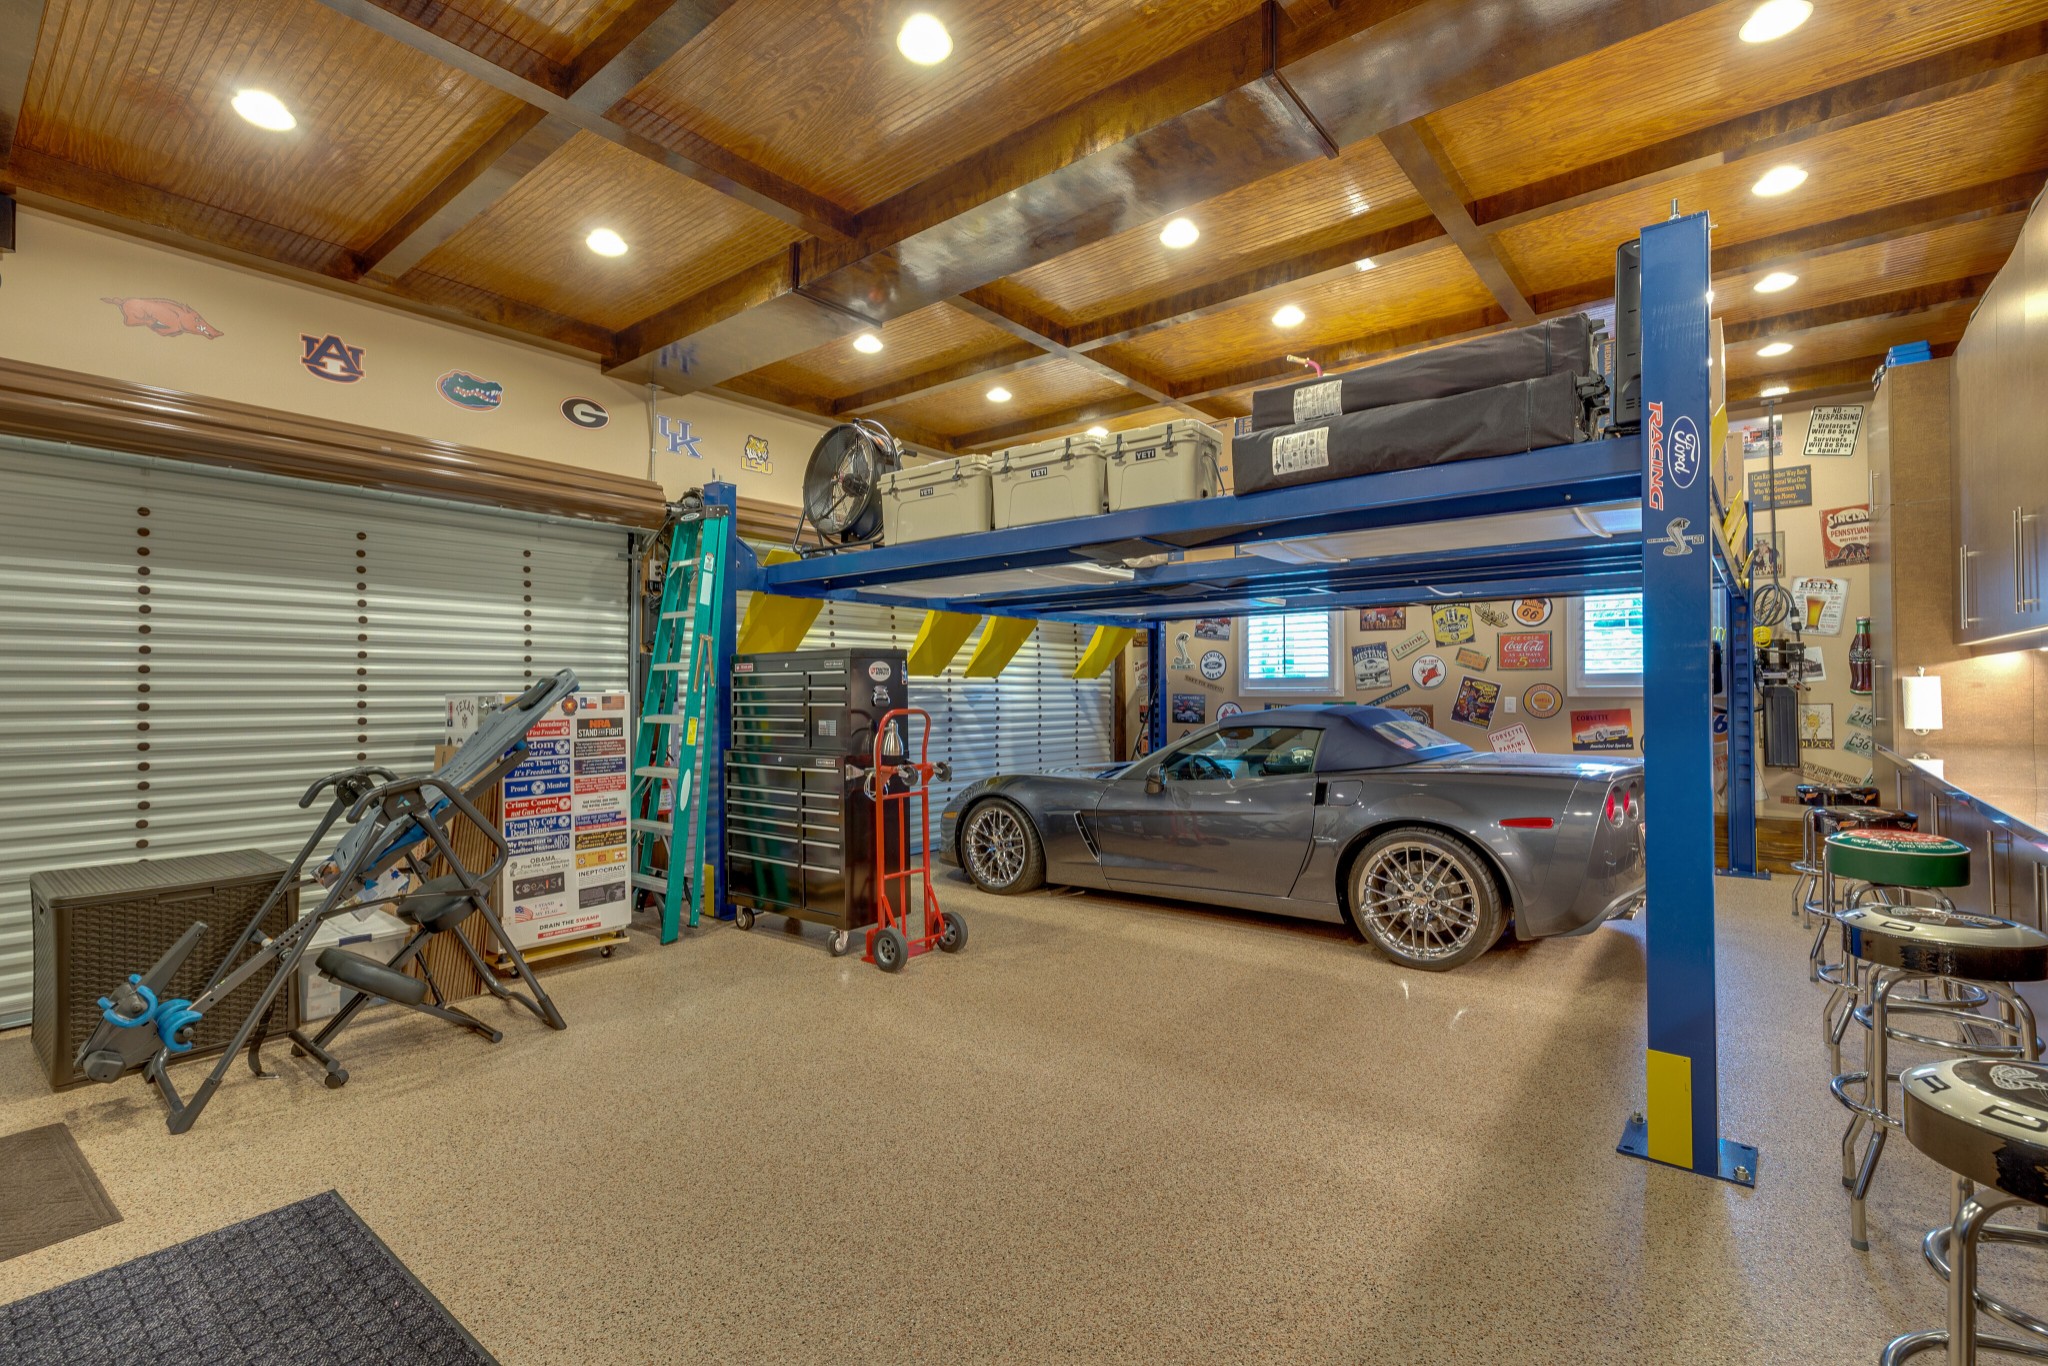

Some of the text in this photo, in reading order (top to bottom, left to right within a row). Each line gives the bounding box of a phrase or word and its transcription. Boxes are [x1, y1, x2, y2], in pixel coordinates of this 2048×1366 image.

[1814, 413, 1860, 421] TRESPASSING
[657, 414, 703, 460] UK
[1137, 449, 1155, 460] YETI
[1648, 401, 1664, 511] RACING
[1673, 430, 1696, 476] Ford
[741, 455, 774, 475] LSU
[1032, 467, 1047, 478] YETI
[1763, 472, 1785, 480] Rember
[1785, 469, 1797, 477] Way
[920, 488, 934, 497] YETI
[1774, 485, 1795, 493] Generous
[1827, 511, 1870, 529] SINCLAI
[1830, 525, 1870, 538] PENNSYLVAN
[1799, 581, 1839, 590] BEER
[1521, 607, 1540, 619] 66
[1361, 619, 1405, 630] MY RULES!
[1400, 635, 1424, 651] think
[1203, 651, 1224, 662] GENUINE
[1353, 649, 1388, 663] MUSTANG
[1516, 656, 1529, 667] 5
[1205, 670, 1223, 678] PARTS
[1392, 687, 1408, 697] THEM
[455, 699, 475, 716] TEXAS
[589, 719, 611, 728] NRA
[1851, 710, 1873, 726] 245
[537, 720, 570, 728] Amendment,
[578, 728, 598, 737] STAND
[605, 727, 622, 736] FIGHT
[1491, 727, 1523, 743] CORVETTE
[1498, 739, 1526, 752] PARKING
[1848, 735, 1871, 750] C36
[534, 759, 551, 767] Than
[525, 767, 557, 776] Freedom!!
[510, 785, 528, 793] Proud
[505, 797, 559, 810] Crime Control
[510, 805, 558, 818] not Gun Control
[529, 819, 541, 827] My
[541, 817, 557, 826] Cold
[510, 829, 528, 837] Dead
[518, 838, 546, 846] President
[578, 864, 626, 877] INEPTOCRACY
[539, 921, 561, 930] DRAIN
[575, 914, 600, 923] SWAMP
